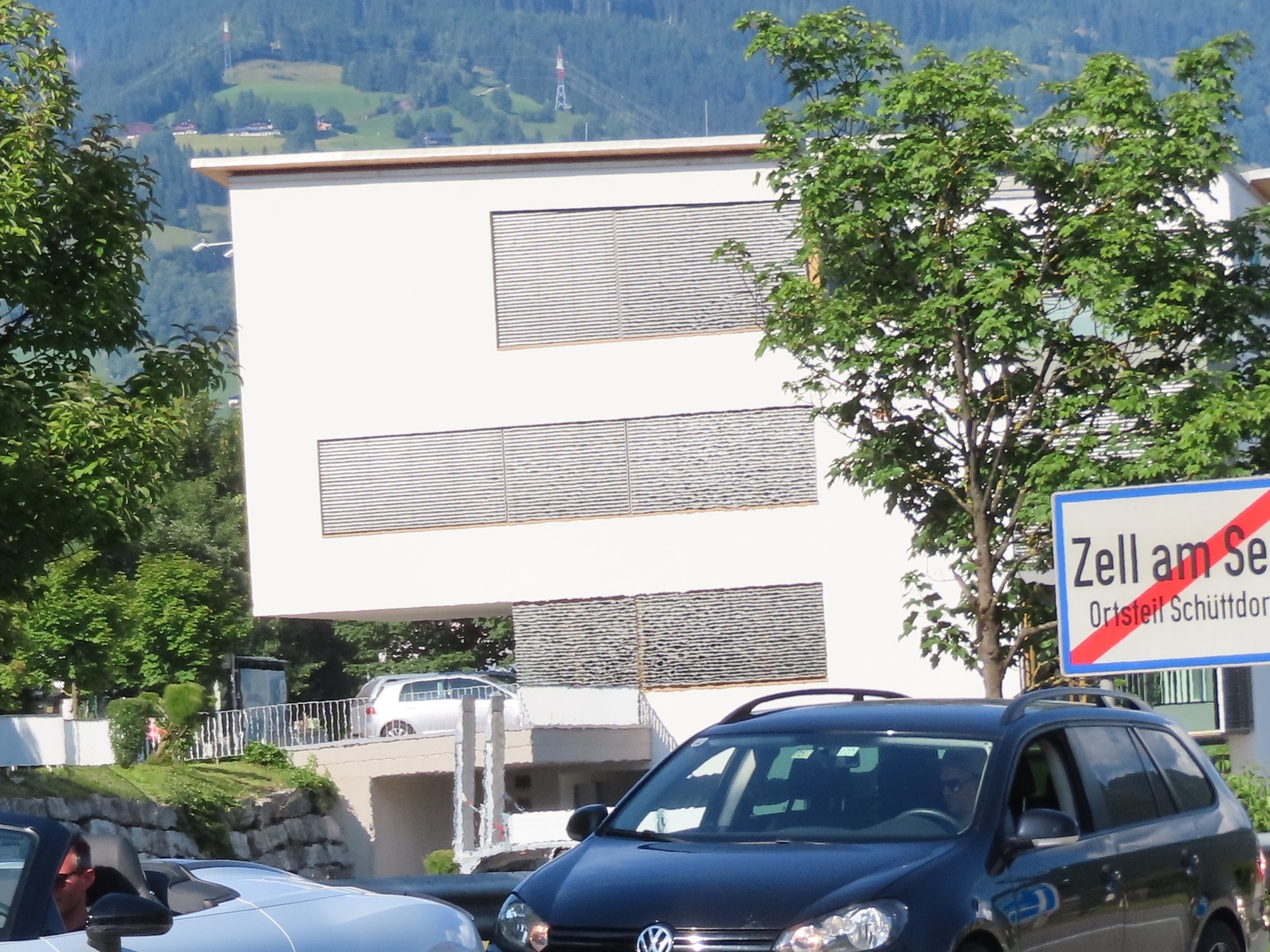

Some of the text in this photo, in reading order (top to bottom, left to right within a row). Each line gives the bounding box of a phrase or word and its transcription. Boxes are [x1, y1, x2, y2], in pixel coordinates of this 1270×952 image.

[1071, 525, 1268, 587] Zell am Se
[1090, 591, 1270, 628] Ortsteil Schüttdor
